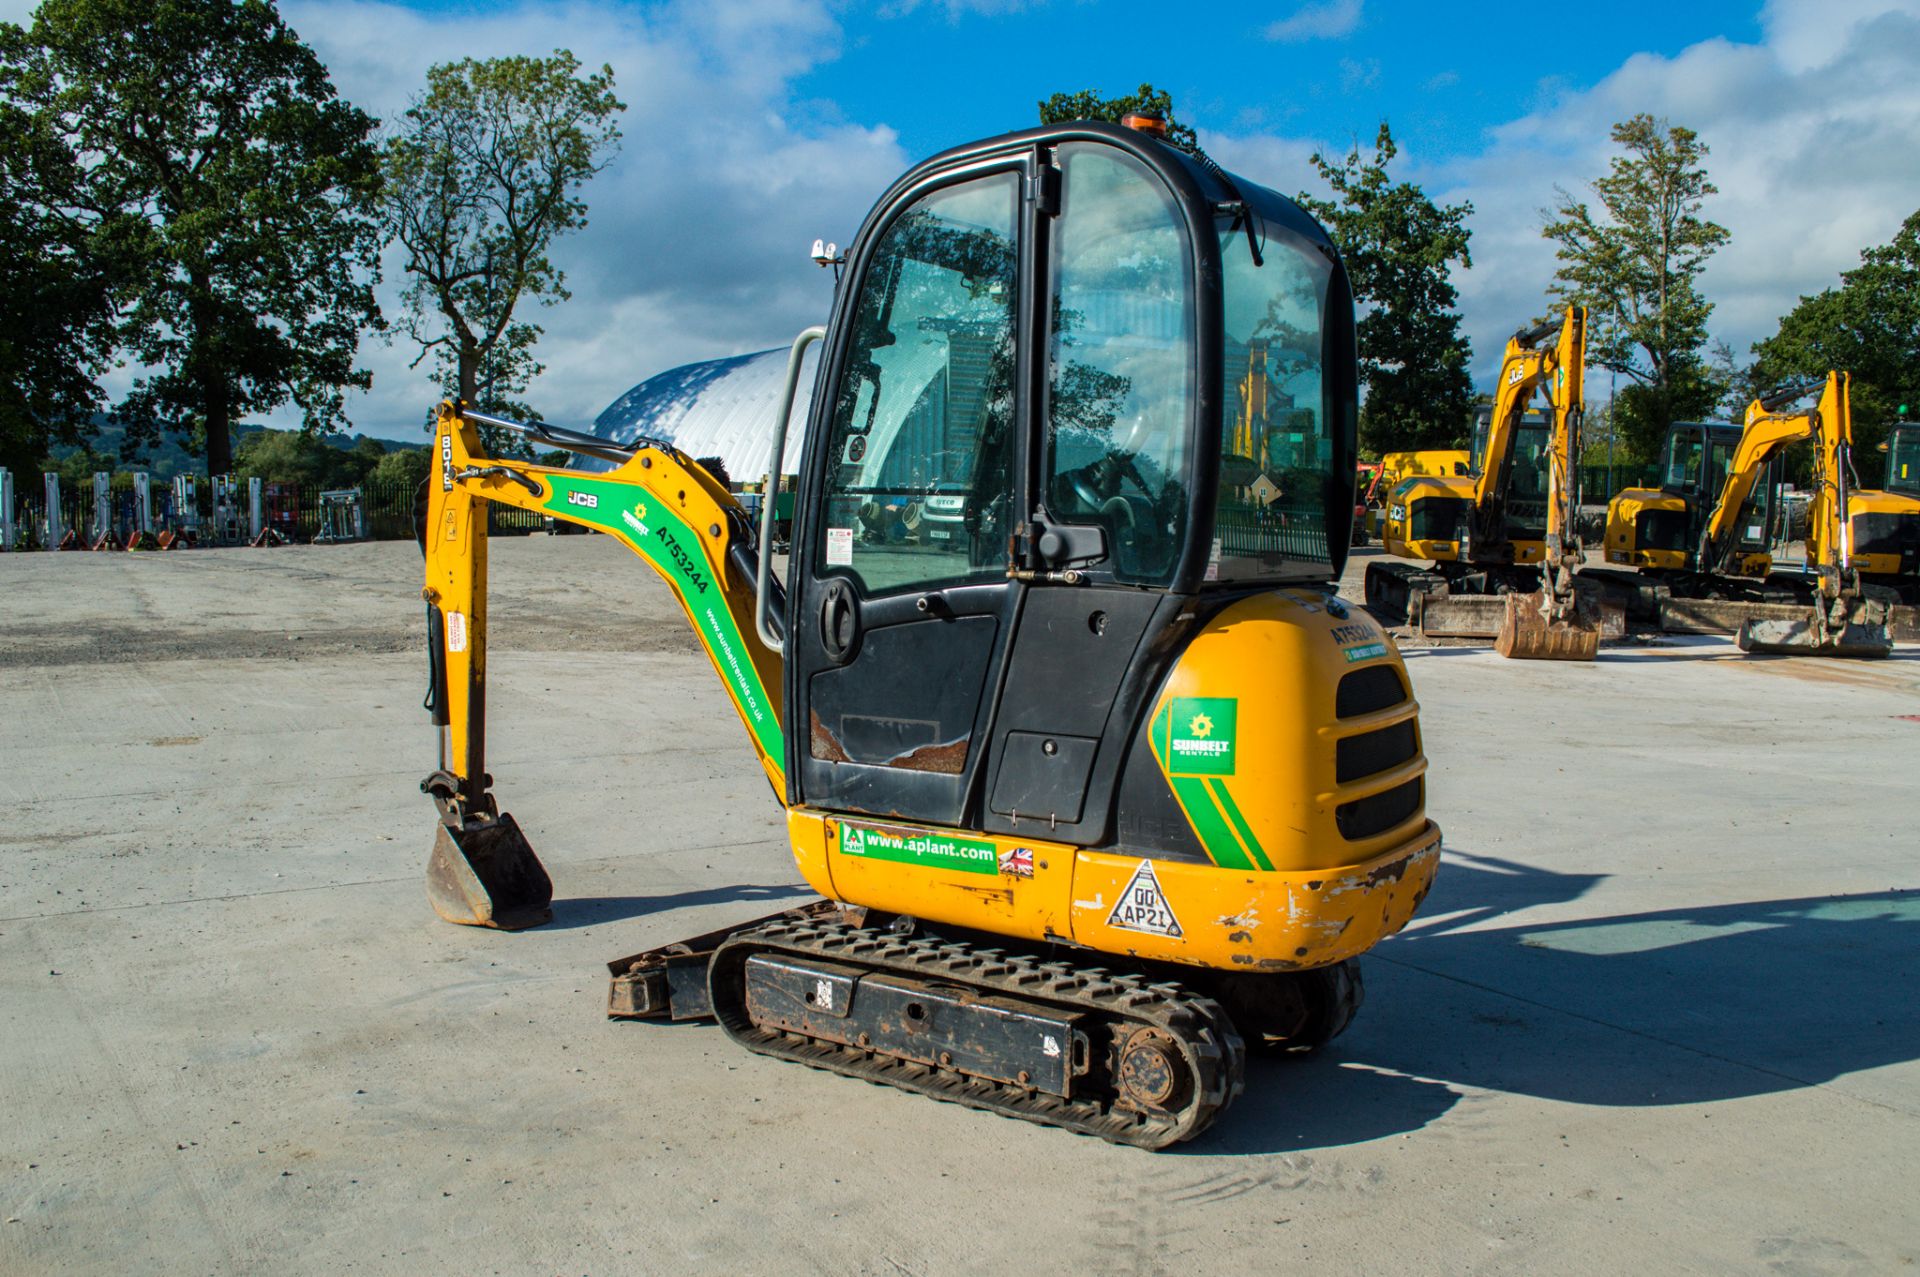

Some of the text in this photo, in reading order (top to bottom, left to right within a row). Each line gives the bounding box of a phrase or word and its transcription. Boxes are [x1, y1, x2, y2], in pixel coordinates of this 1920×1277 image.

[568, 490, 598, 509] JCB
[1390, 506, 1406, 521] JCB
[656, 526, 708, 594] A753244
[705, 607, 763, 723] www.sunbeltrentals.co.uk
[1172, 739, 1229, 752] SUNBELT
[867, 834, 994, 862] www.aplant.com
